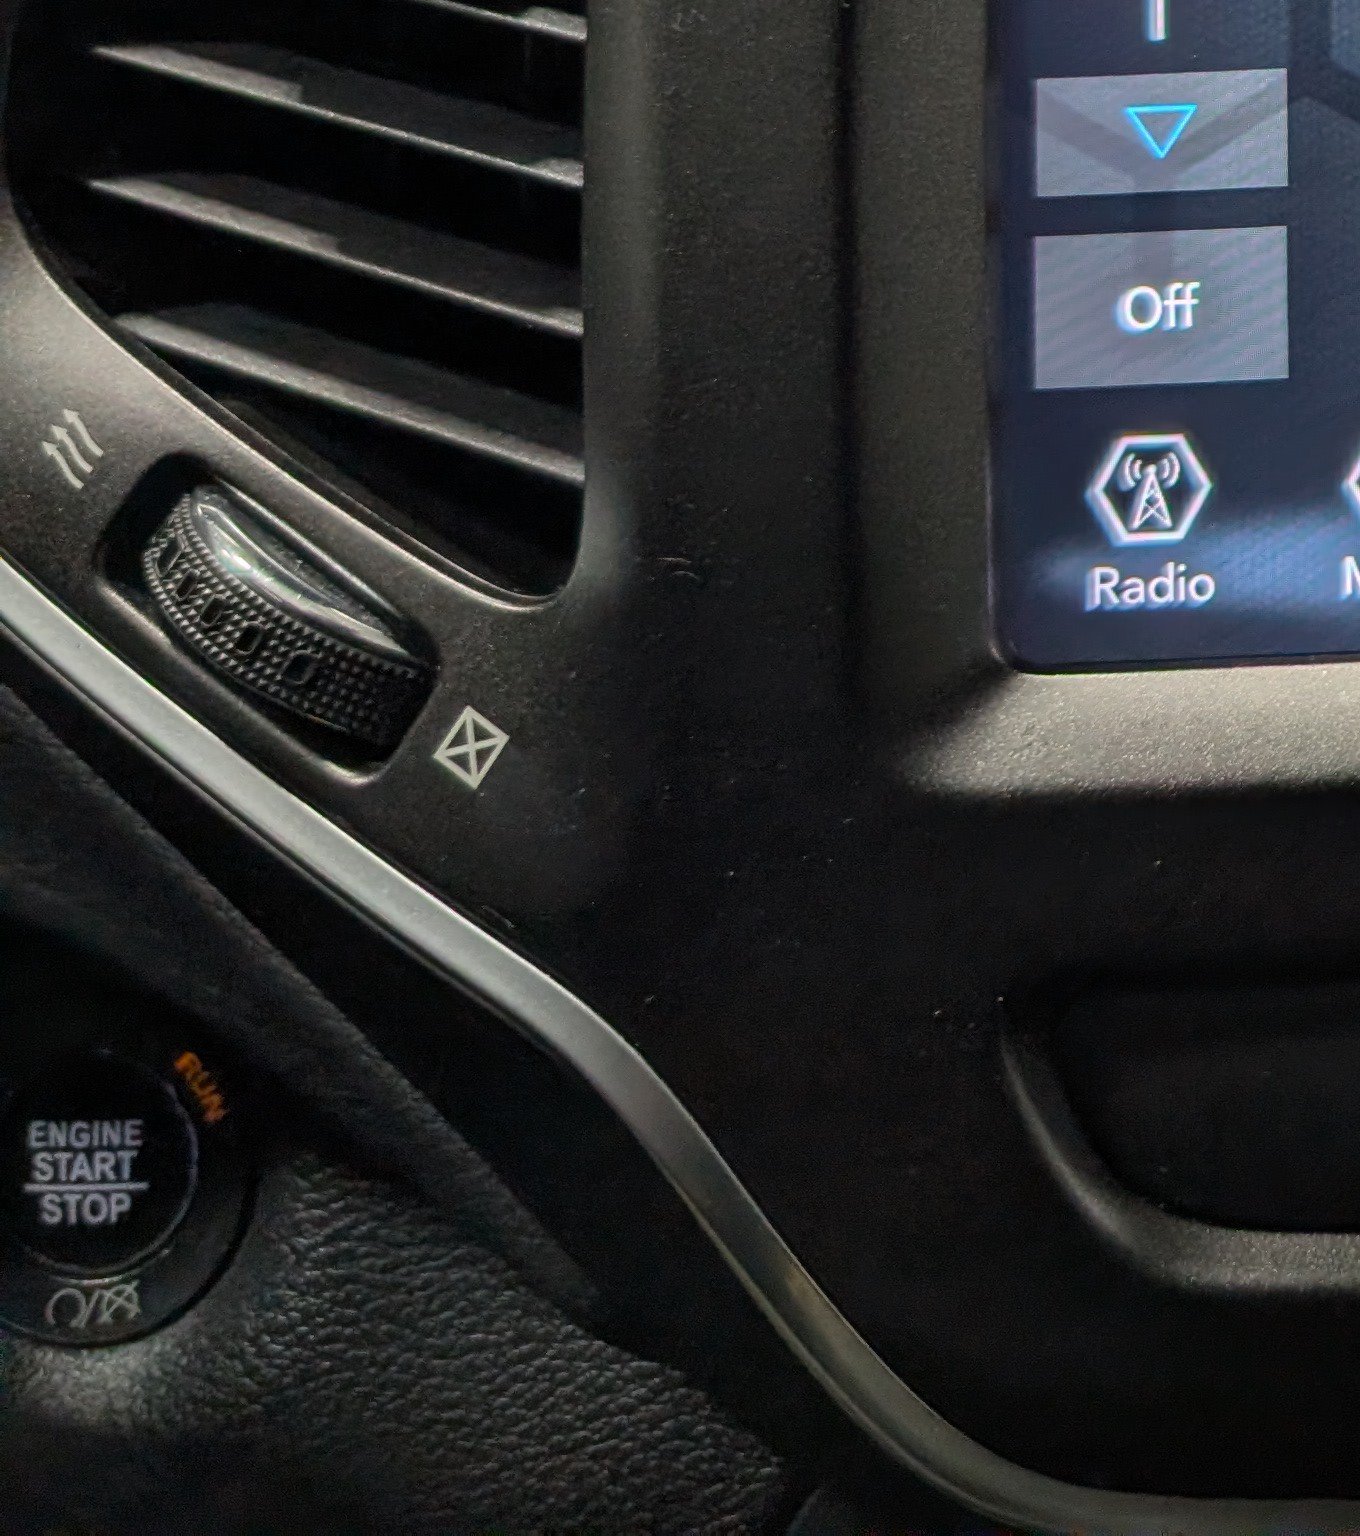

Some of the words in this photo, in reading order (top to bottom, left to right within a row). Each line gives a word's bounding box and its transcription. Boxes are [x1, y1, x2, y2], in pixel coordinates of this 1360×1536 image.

[1117, 283, 1199, 332] Off
[1086, 562, 1215, 610] Radio
[28, 1119, 144, 1149] ENGINE
[32, 1150, 138, 1183] START
[41, 1193, 132, 1225] STOP
